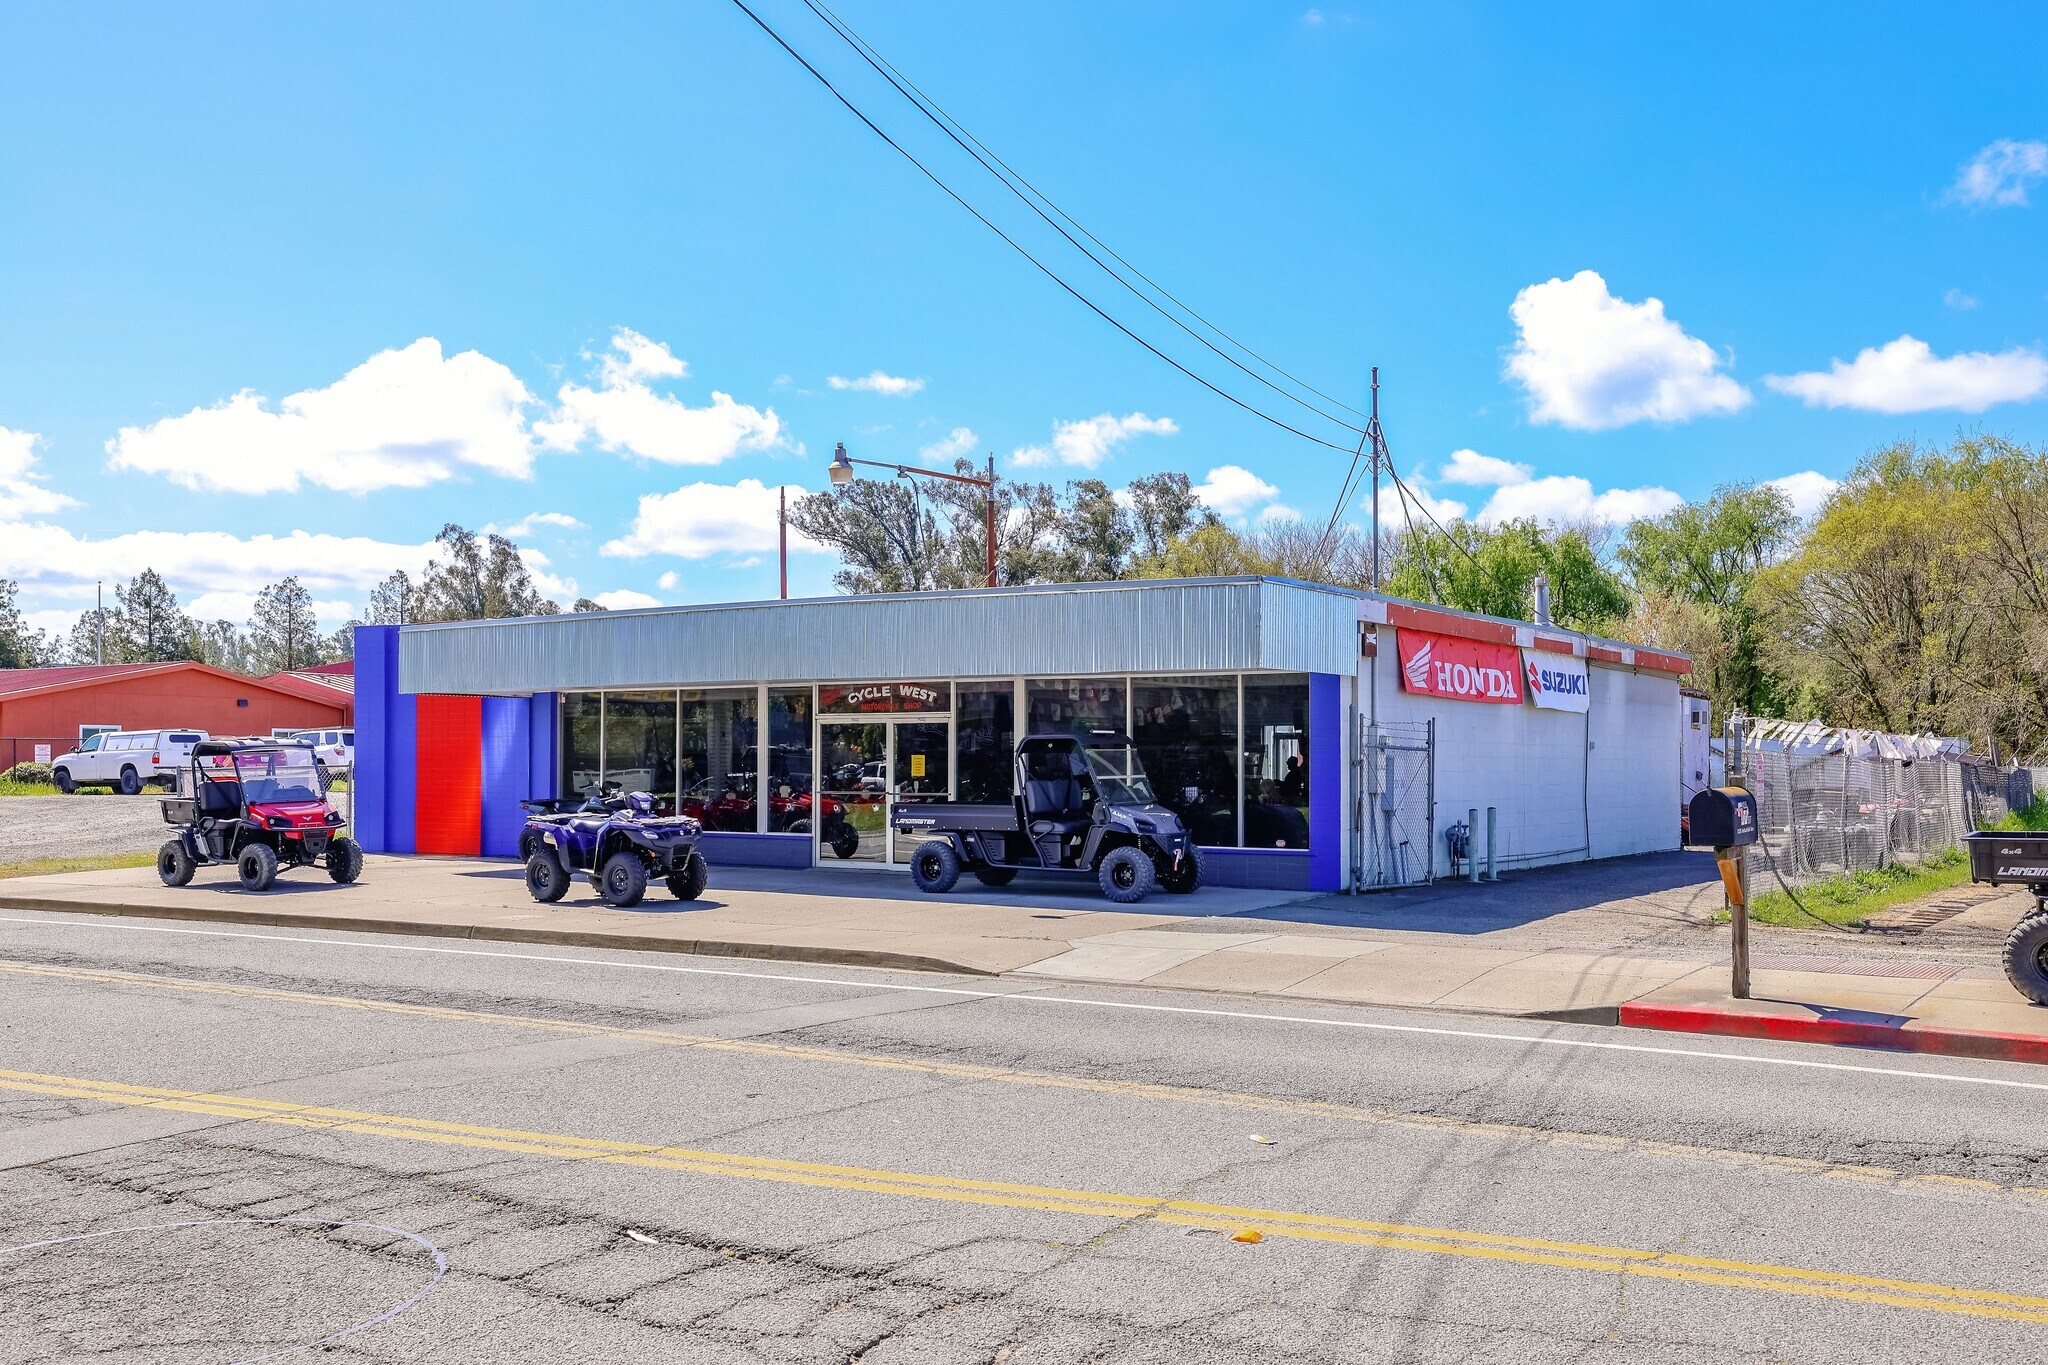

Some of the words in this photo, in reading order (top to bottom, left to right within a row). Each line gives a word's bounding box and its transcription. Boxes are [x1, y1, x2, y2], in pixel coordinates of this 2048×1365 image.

[1434, 661, 1518, 699] HONDA
[1541, 669, 1587, 696] SUZUKI
[848, 685, 891, 704] CYCLE
[899, 684, 938, 703] WEST
[861, 703, 900, 711] MOTORCYCLE
[903, 702, 921, 710] SHOP
[1997, 866, 2048, 876] LANDM
